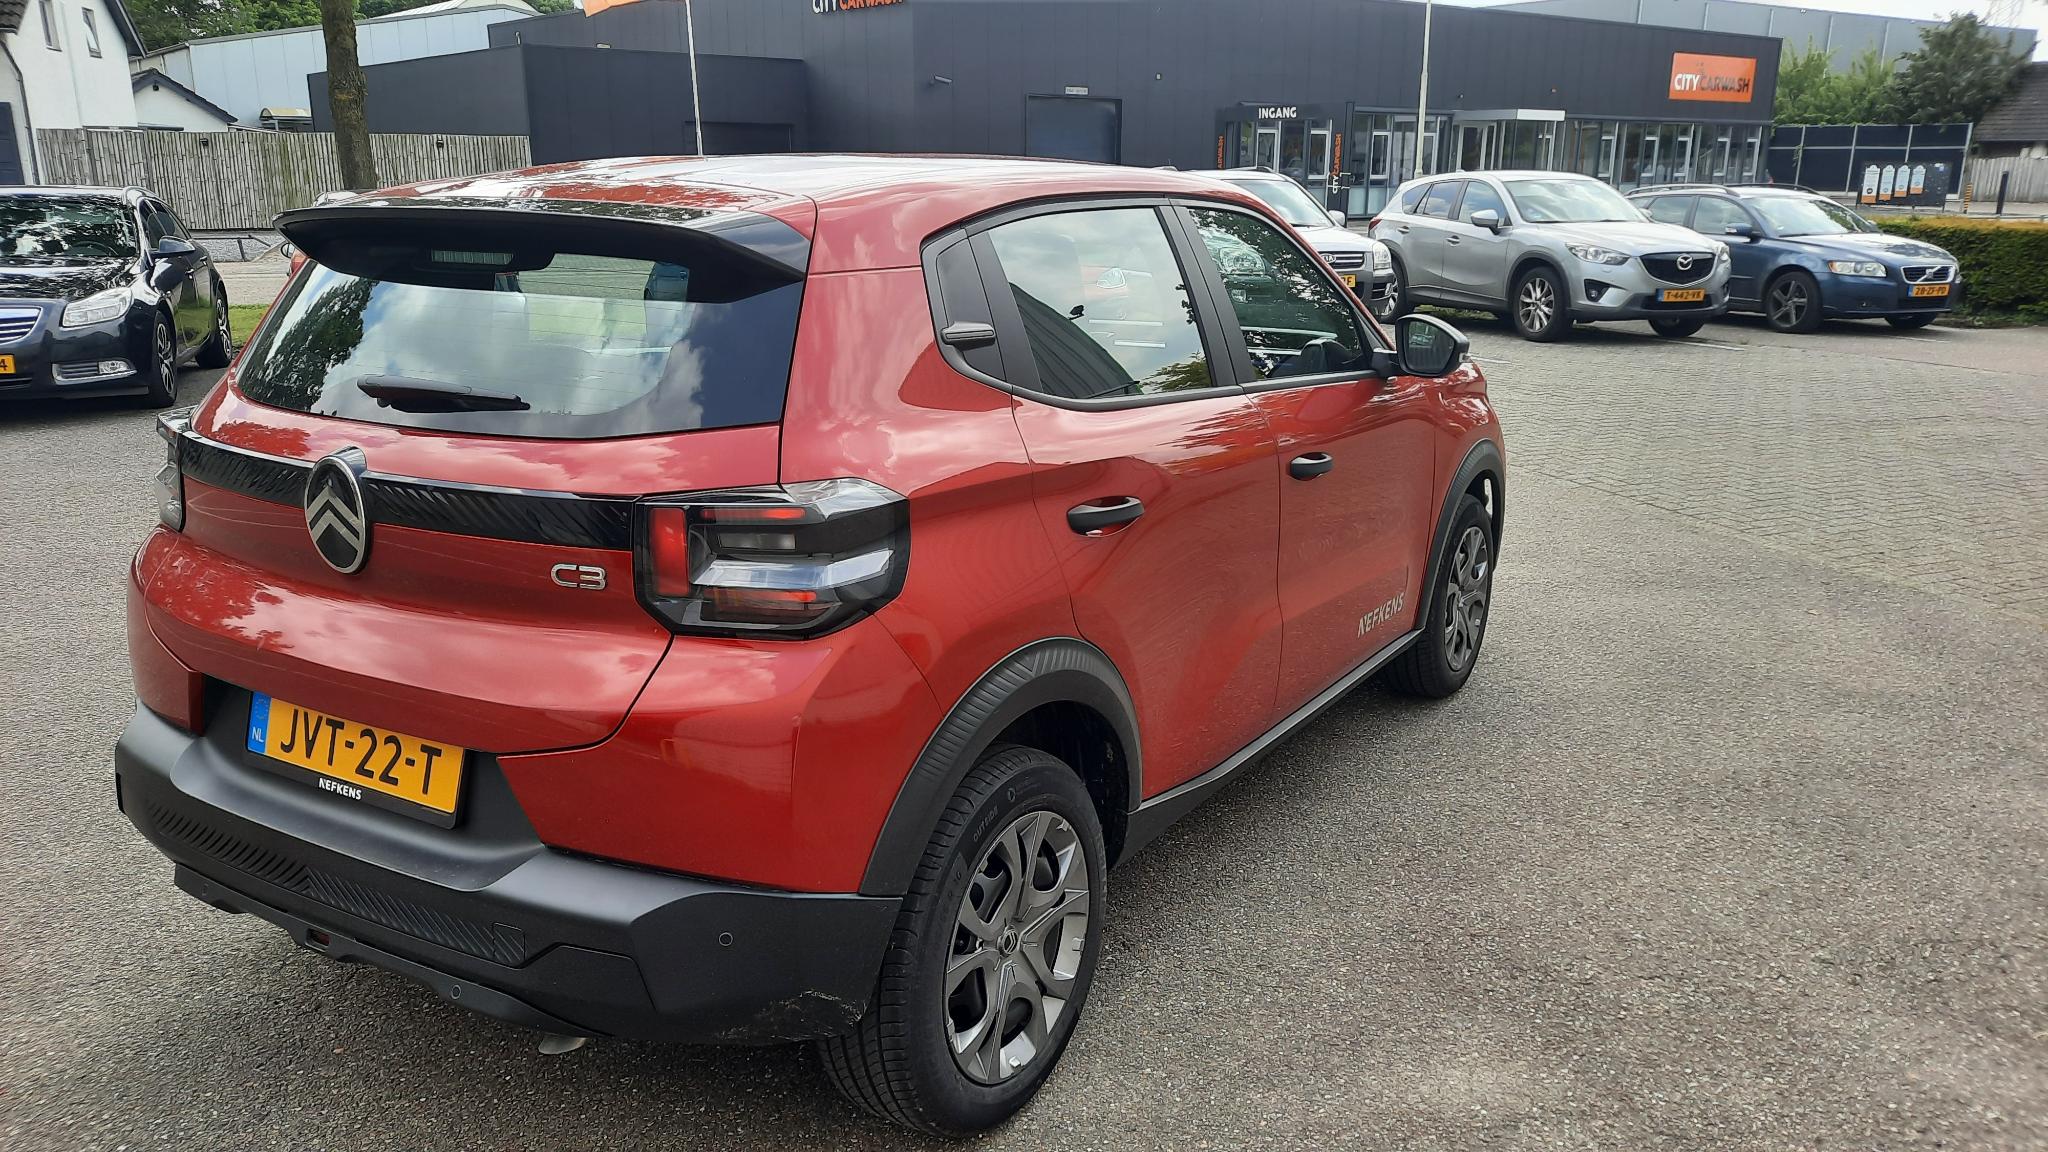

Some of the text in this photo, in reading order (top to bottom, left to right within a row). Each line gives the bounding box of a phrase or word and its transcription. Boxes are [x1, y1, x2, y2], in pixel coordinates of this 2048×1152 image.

[1674, 73, 1699, 91] CITY
[1258, 106, 1297, 119] INGANG
[551, 563, 606, 590] C3
[1357, 592, 1404, 638] NEFKENS
[252, 708, 442, 795] NL JVT-22-T
[318, 777, 362, 800] NEFKENS
